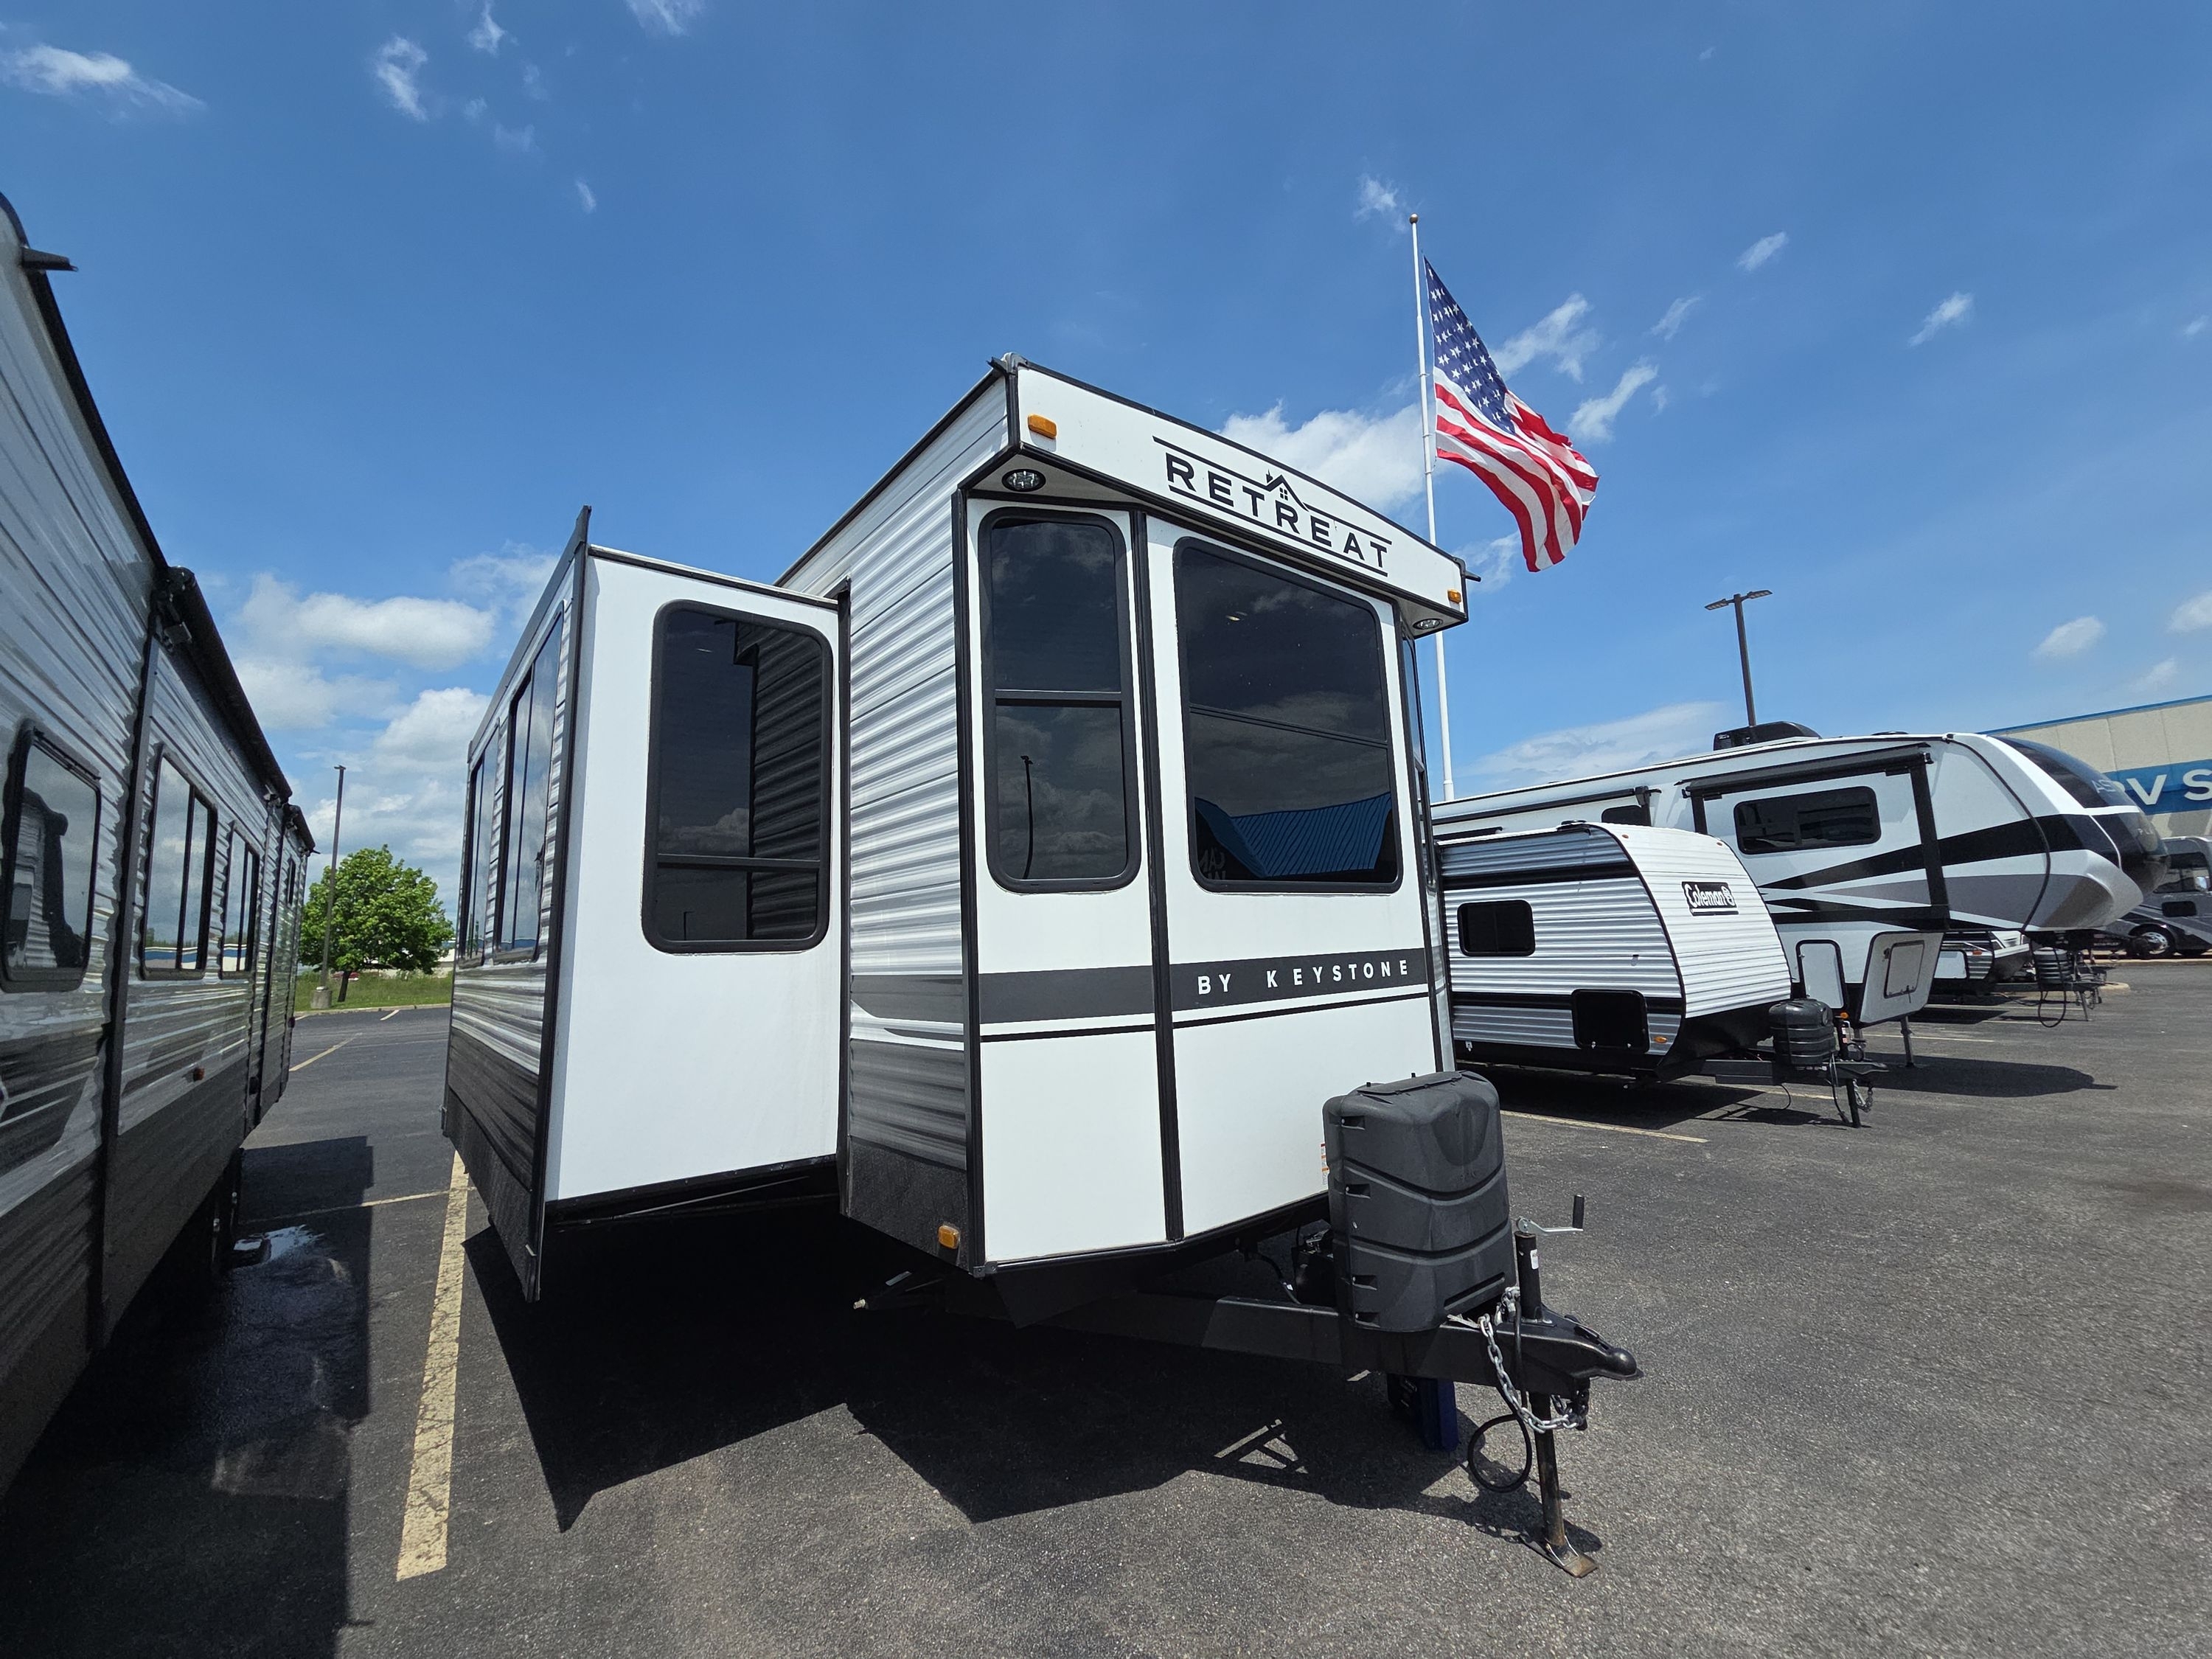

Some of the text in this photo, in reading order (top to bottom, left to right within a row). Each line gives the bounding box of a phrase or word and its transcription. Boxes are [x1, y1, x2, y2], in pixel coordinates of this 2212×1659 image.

[1166, 452, 1388, 568] RETREAT
[1684, 883, 1728, 908] Coleman
[1197, 959, 1408, 995] BY KEYSTONE
